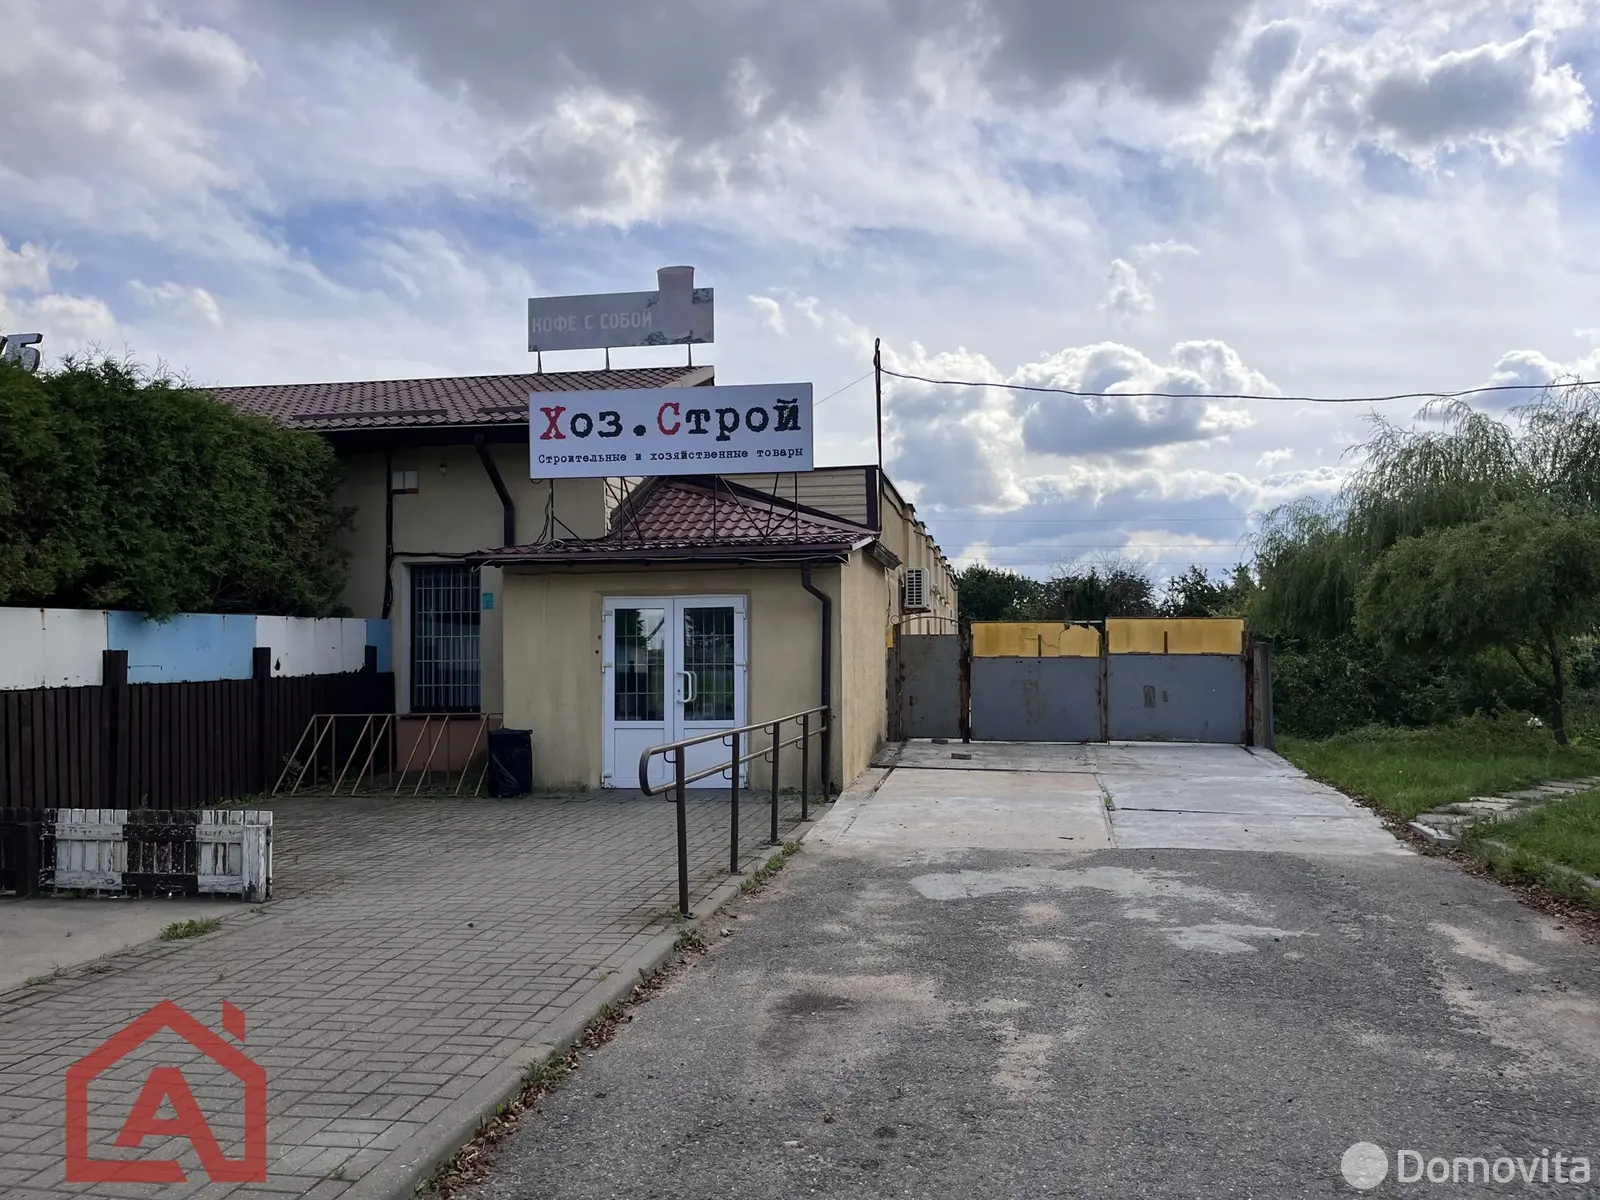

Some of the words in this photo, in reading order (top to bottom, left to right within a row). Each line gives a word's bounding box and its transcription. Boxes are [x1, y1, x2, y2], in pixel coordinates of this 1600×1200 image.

[532, 315, 578, 334] КОФЕ
[584, 314, 595, 331] С
[600, 308, 653, 330] СОБОЙ
[538, 453, 627, 465] Строительные
[635, 453, 642, 461] и
[650, 449, 748, 461] хозяйственные
[757, 447, 804, 458] товары
